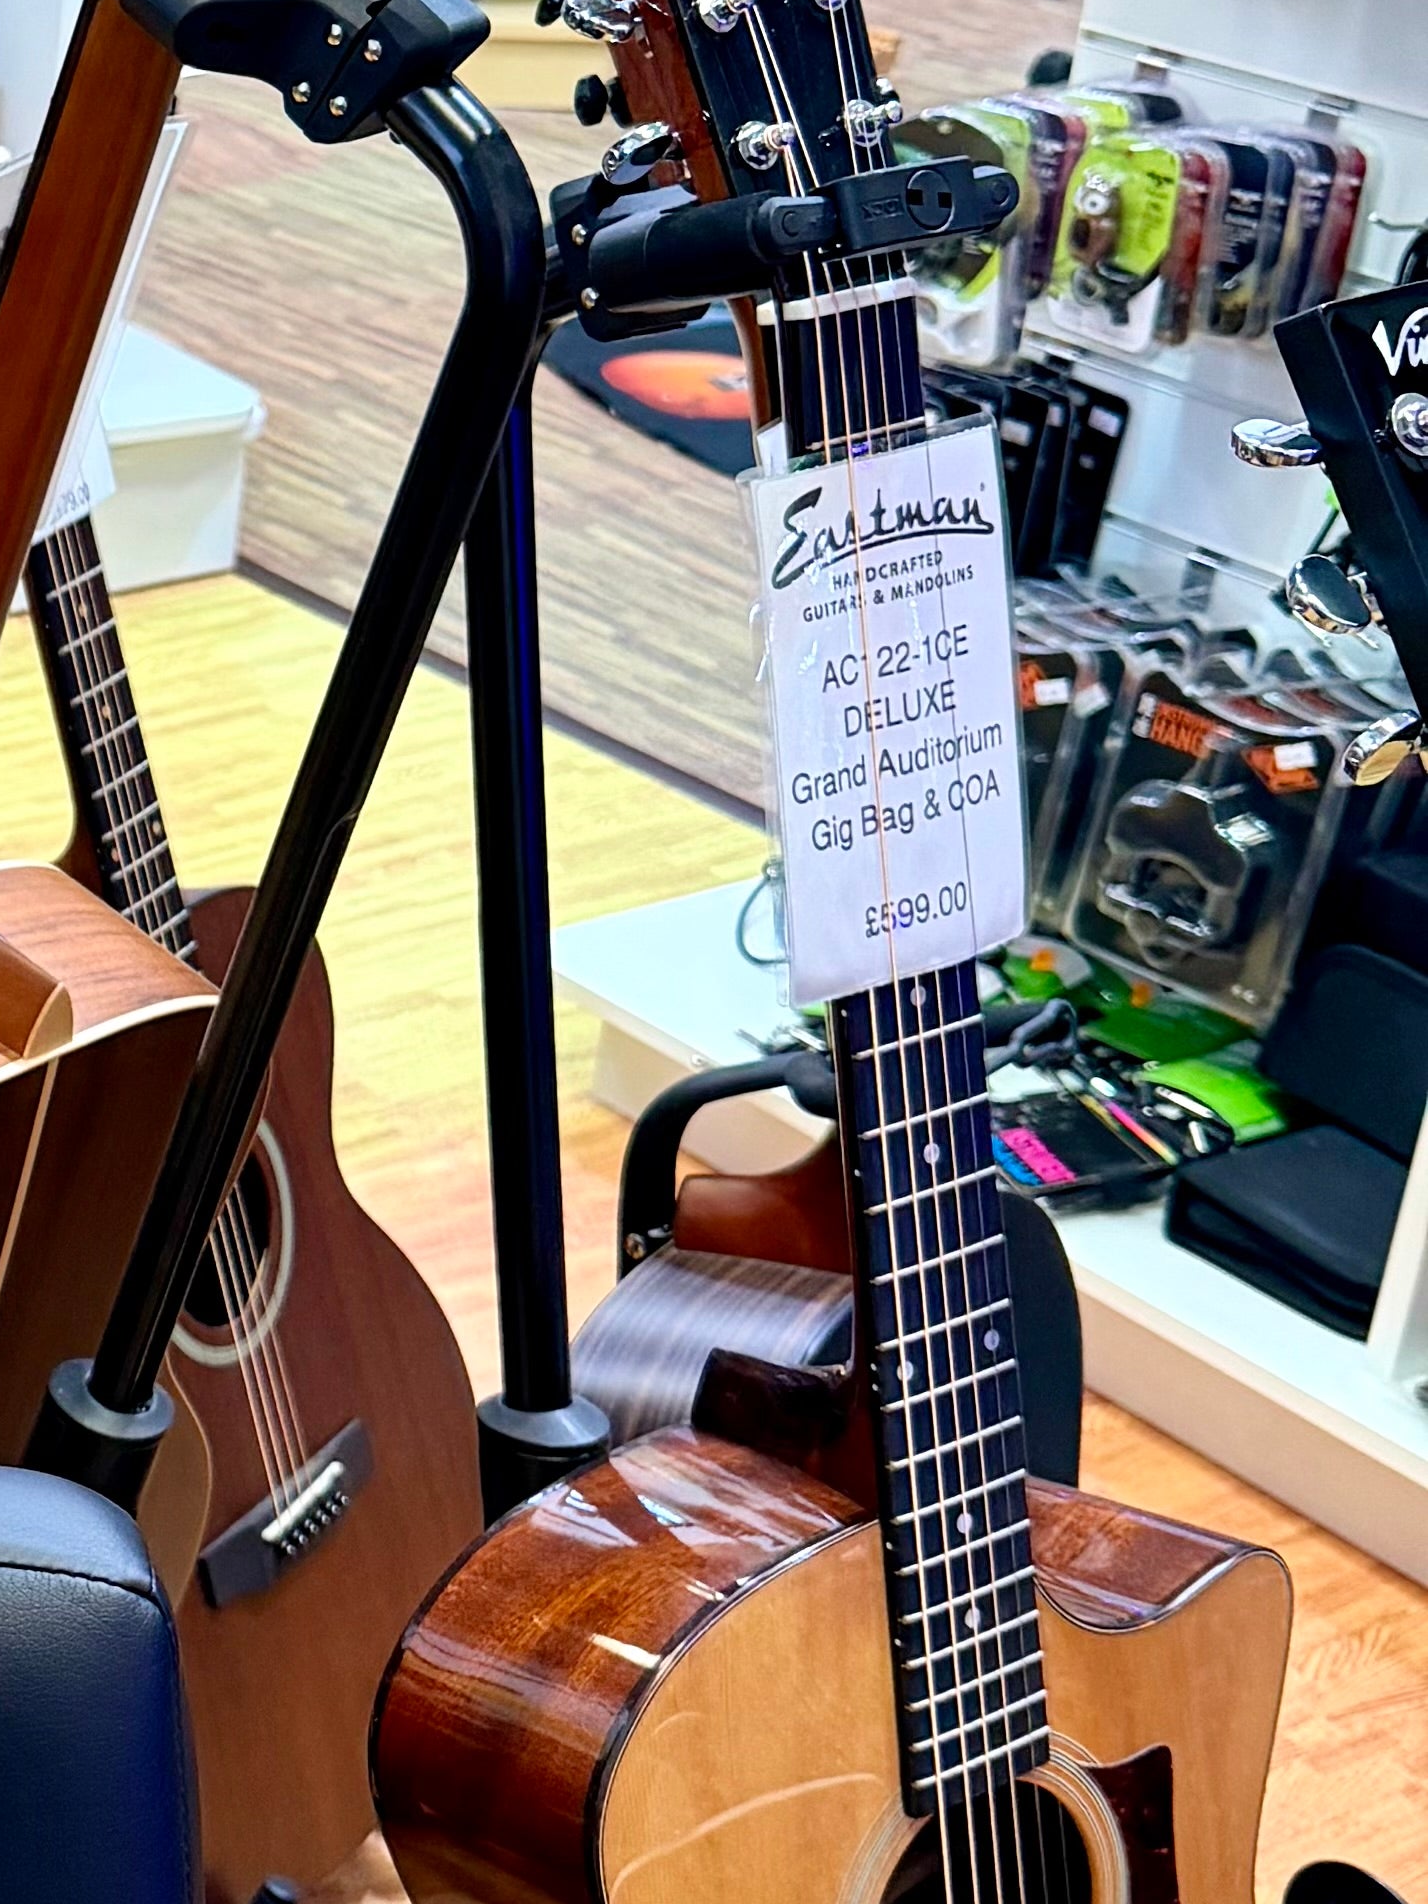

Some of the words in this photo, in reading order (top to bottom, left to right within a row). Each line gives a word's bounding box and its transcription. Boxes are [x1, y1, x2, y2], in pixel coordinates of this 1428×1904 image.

[772, 486, 995, 590] Eastman
[832, 550, 944, 591] HANDCRAFTED
[872, 588, 885, 605] &
[890, 563, 975, 603] MANDOLINS
[843, 679, 957, 738] DELUXE
[791, 755, 867, 805] Grand
[878, 722, 1003, 780] Auditorium
[811, 817, 853, 852] Gig
[860, 800, 914, 838] Bag
[923, 787, 942, 821] &
[947, 768, 1001, 813] COA
[865, 881, 968, 938] £599.00
